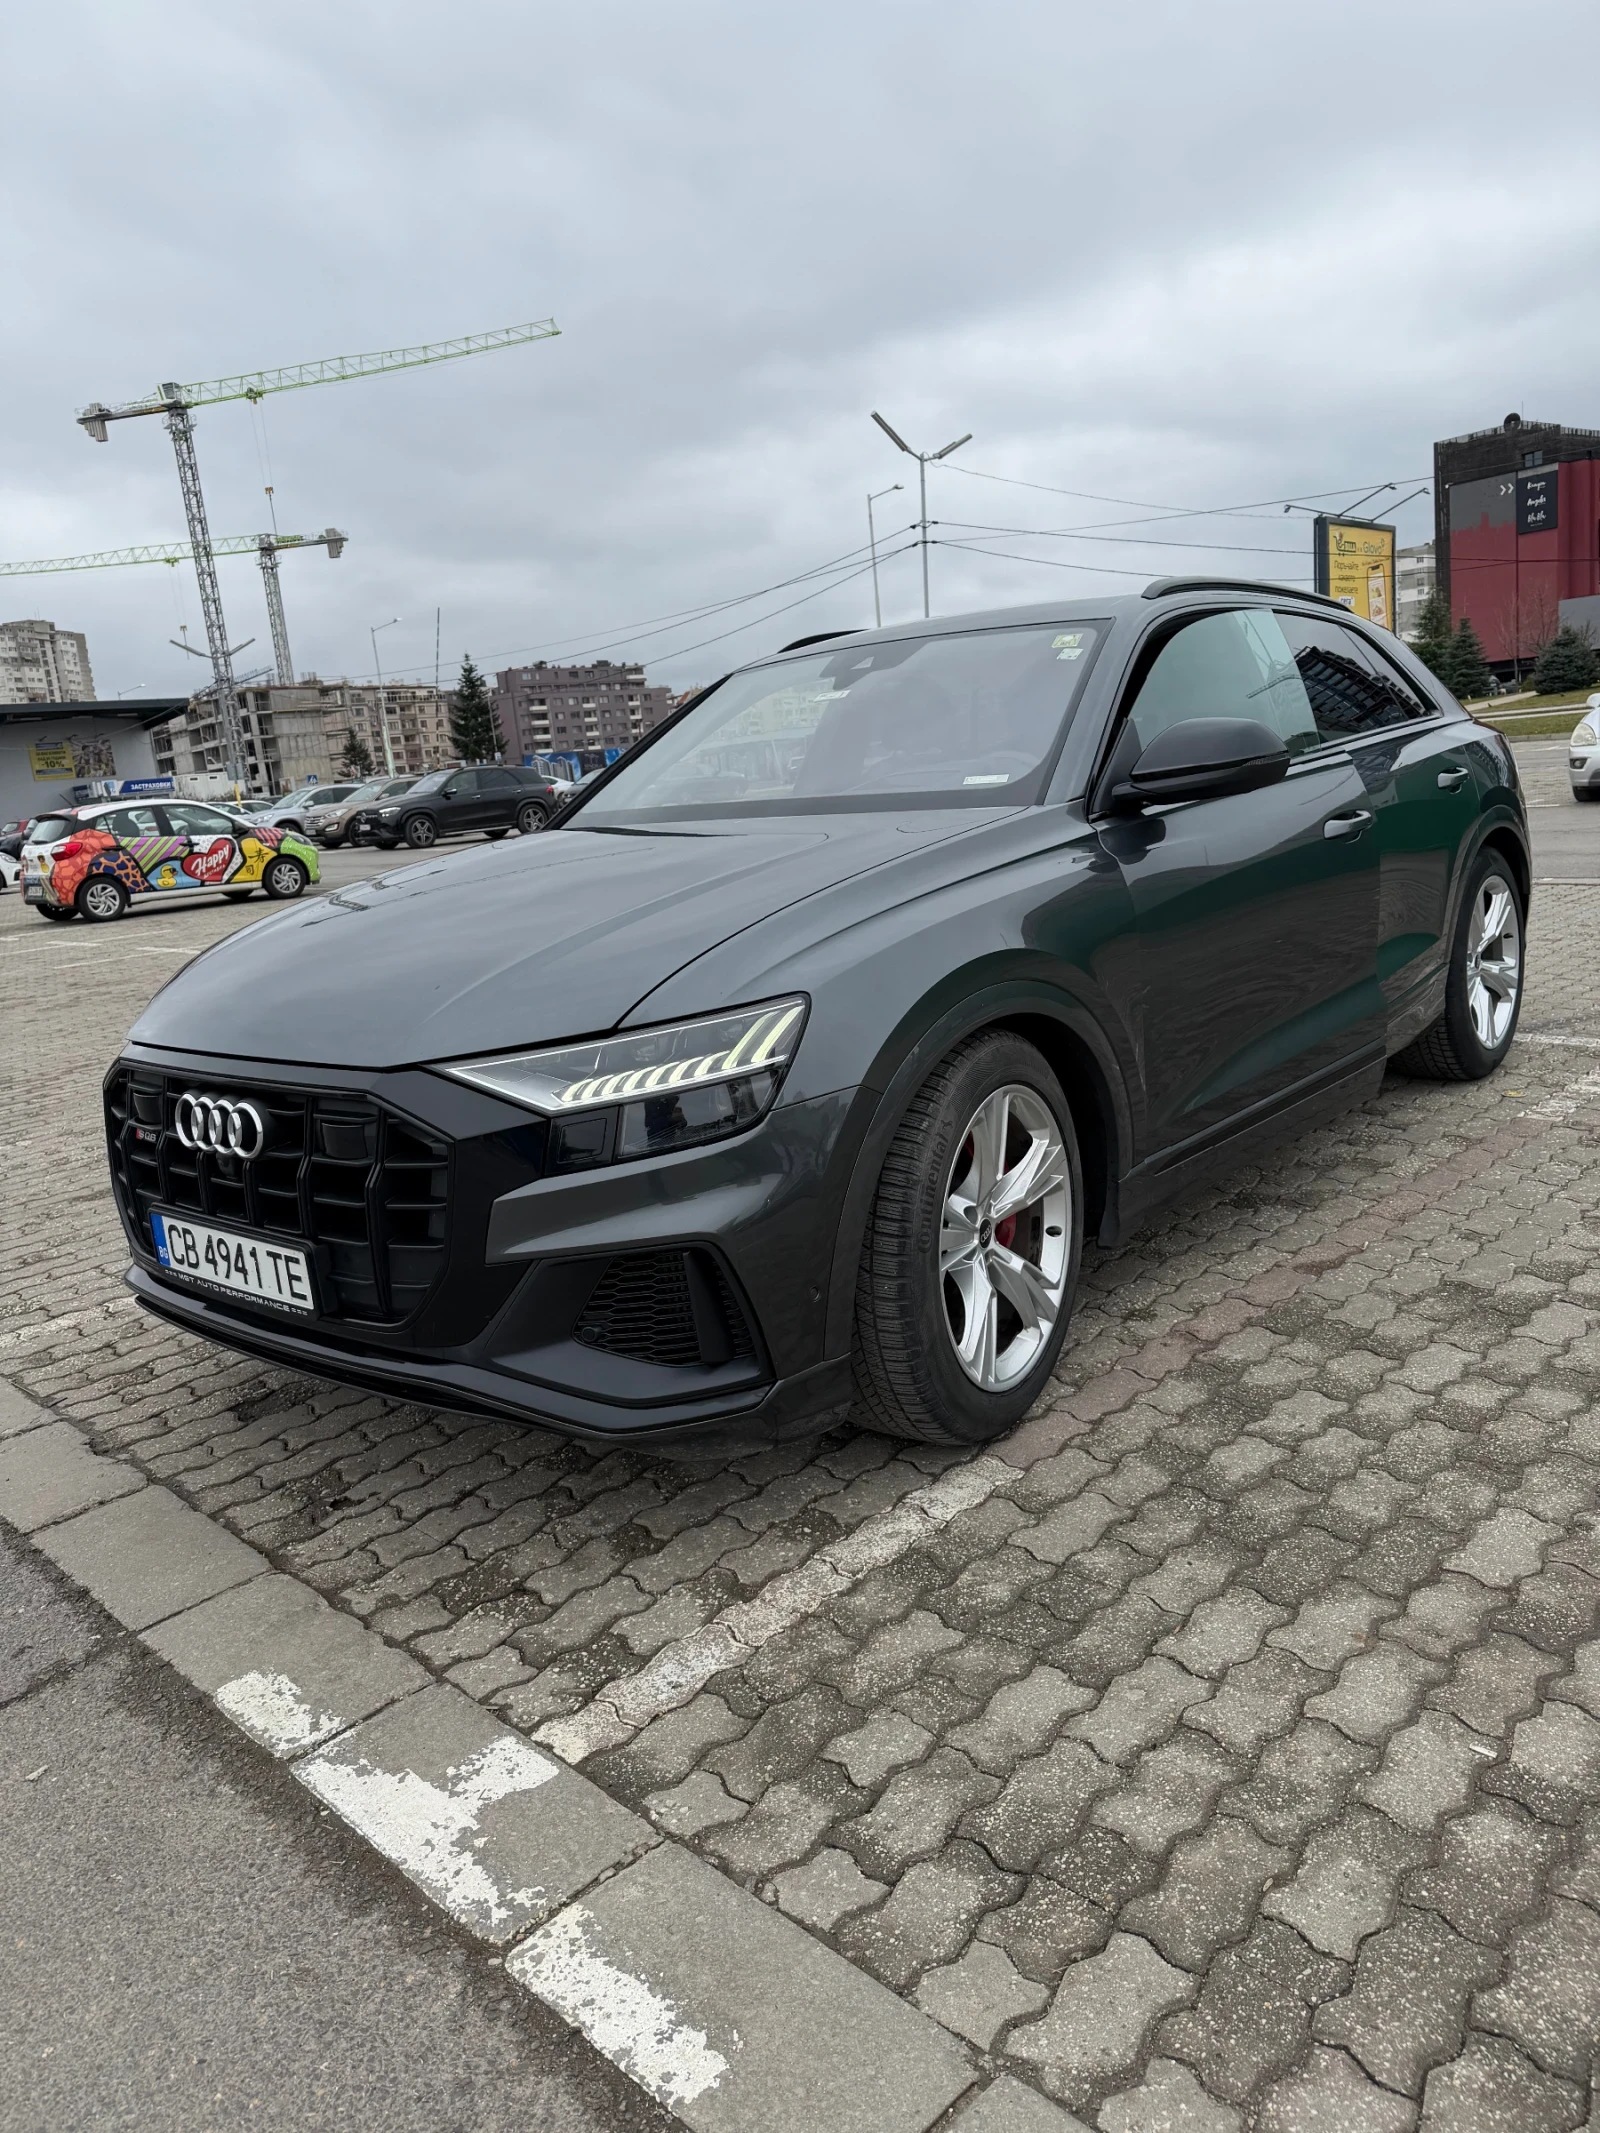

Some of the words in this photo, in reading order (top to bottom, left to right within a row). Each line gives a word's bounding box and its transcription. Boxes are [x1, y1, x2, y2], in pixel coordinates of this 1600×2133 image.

[131, 781, 171, 790] ЗАСТРАХОВКИ
[191, 844, 230, 876] Happy
[917, 1133, 949, 1254] Continental
[157, 1245, 169, 1259] BG
[168, 1224, 200, 1269] CB
[204, 1234, 263, 1289] 4941
[266, 1250, 308, 1301] TE
[197, 1279, 219, 1291] AUTO
[220, 1286, 290, 1312] PERFORMANCE
